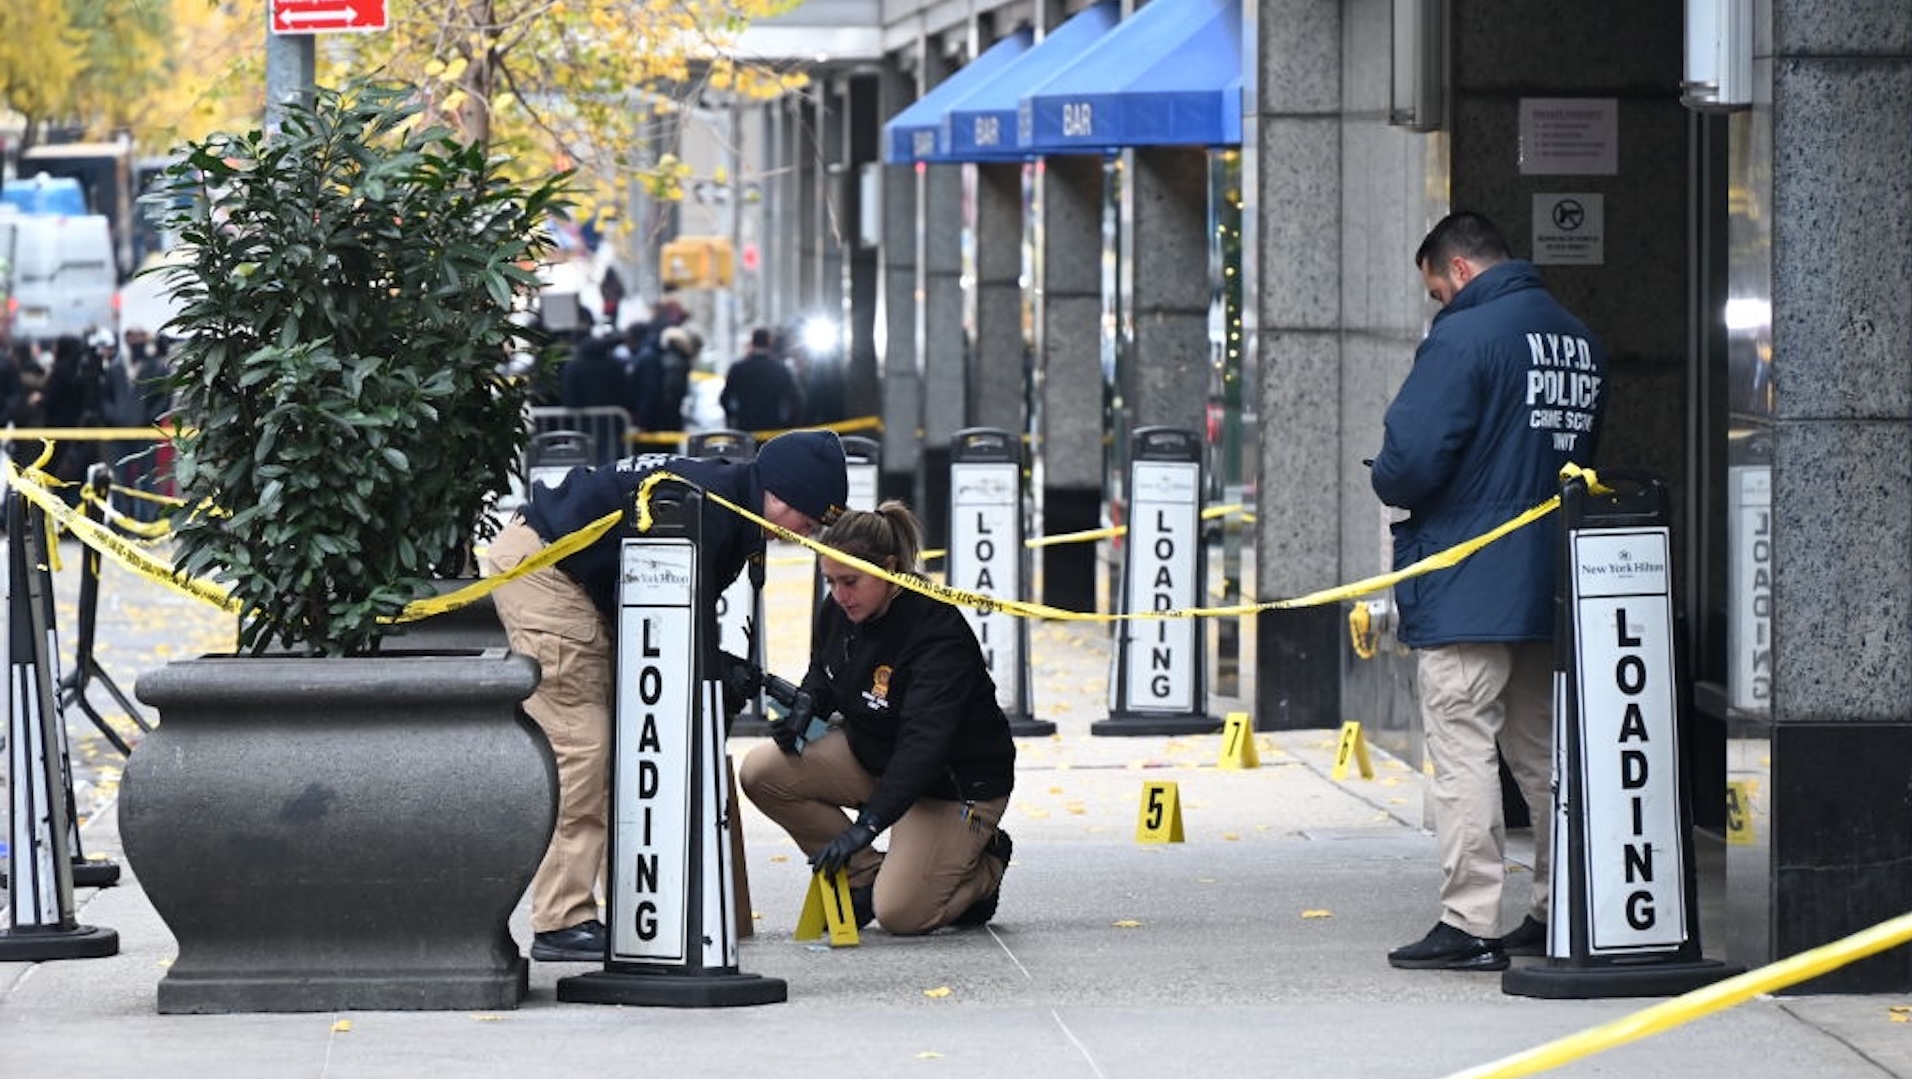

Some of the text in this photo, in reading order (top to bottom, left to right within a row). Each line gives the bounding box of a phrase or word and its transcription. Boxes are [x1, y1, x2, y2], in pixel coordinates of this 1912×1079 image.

[974, 116, 999, 146] BAR
[1062, 102, 1092, 137] BAR
[1525, 332, 1597, 372] N.Y.P.D.
[1525, 369, 1602, 410] POLICE
[1582, 564, 1607, 575] New
[1609, 562, 1633, 574] York
[1151, 509, 1174, 698] LOADING
[1228, 721, 1241, 758] 7
[635, 619, 662, 942] LOADING
[1615, 607, 1656, 932] LOADING
[1145, 787, 1165, 830] 5
